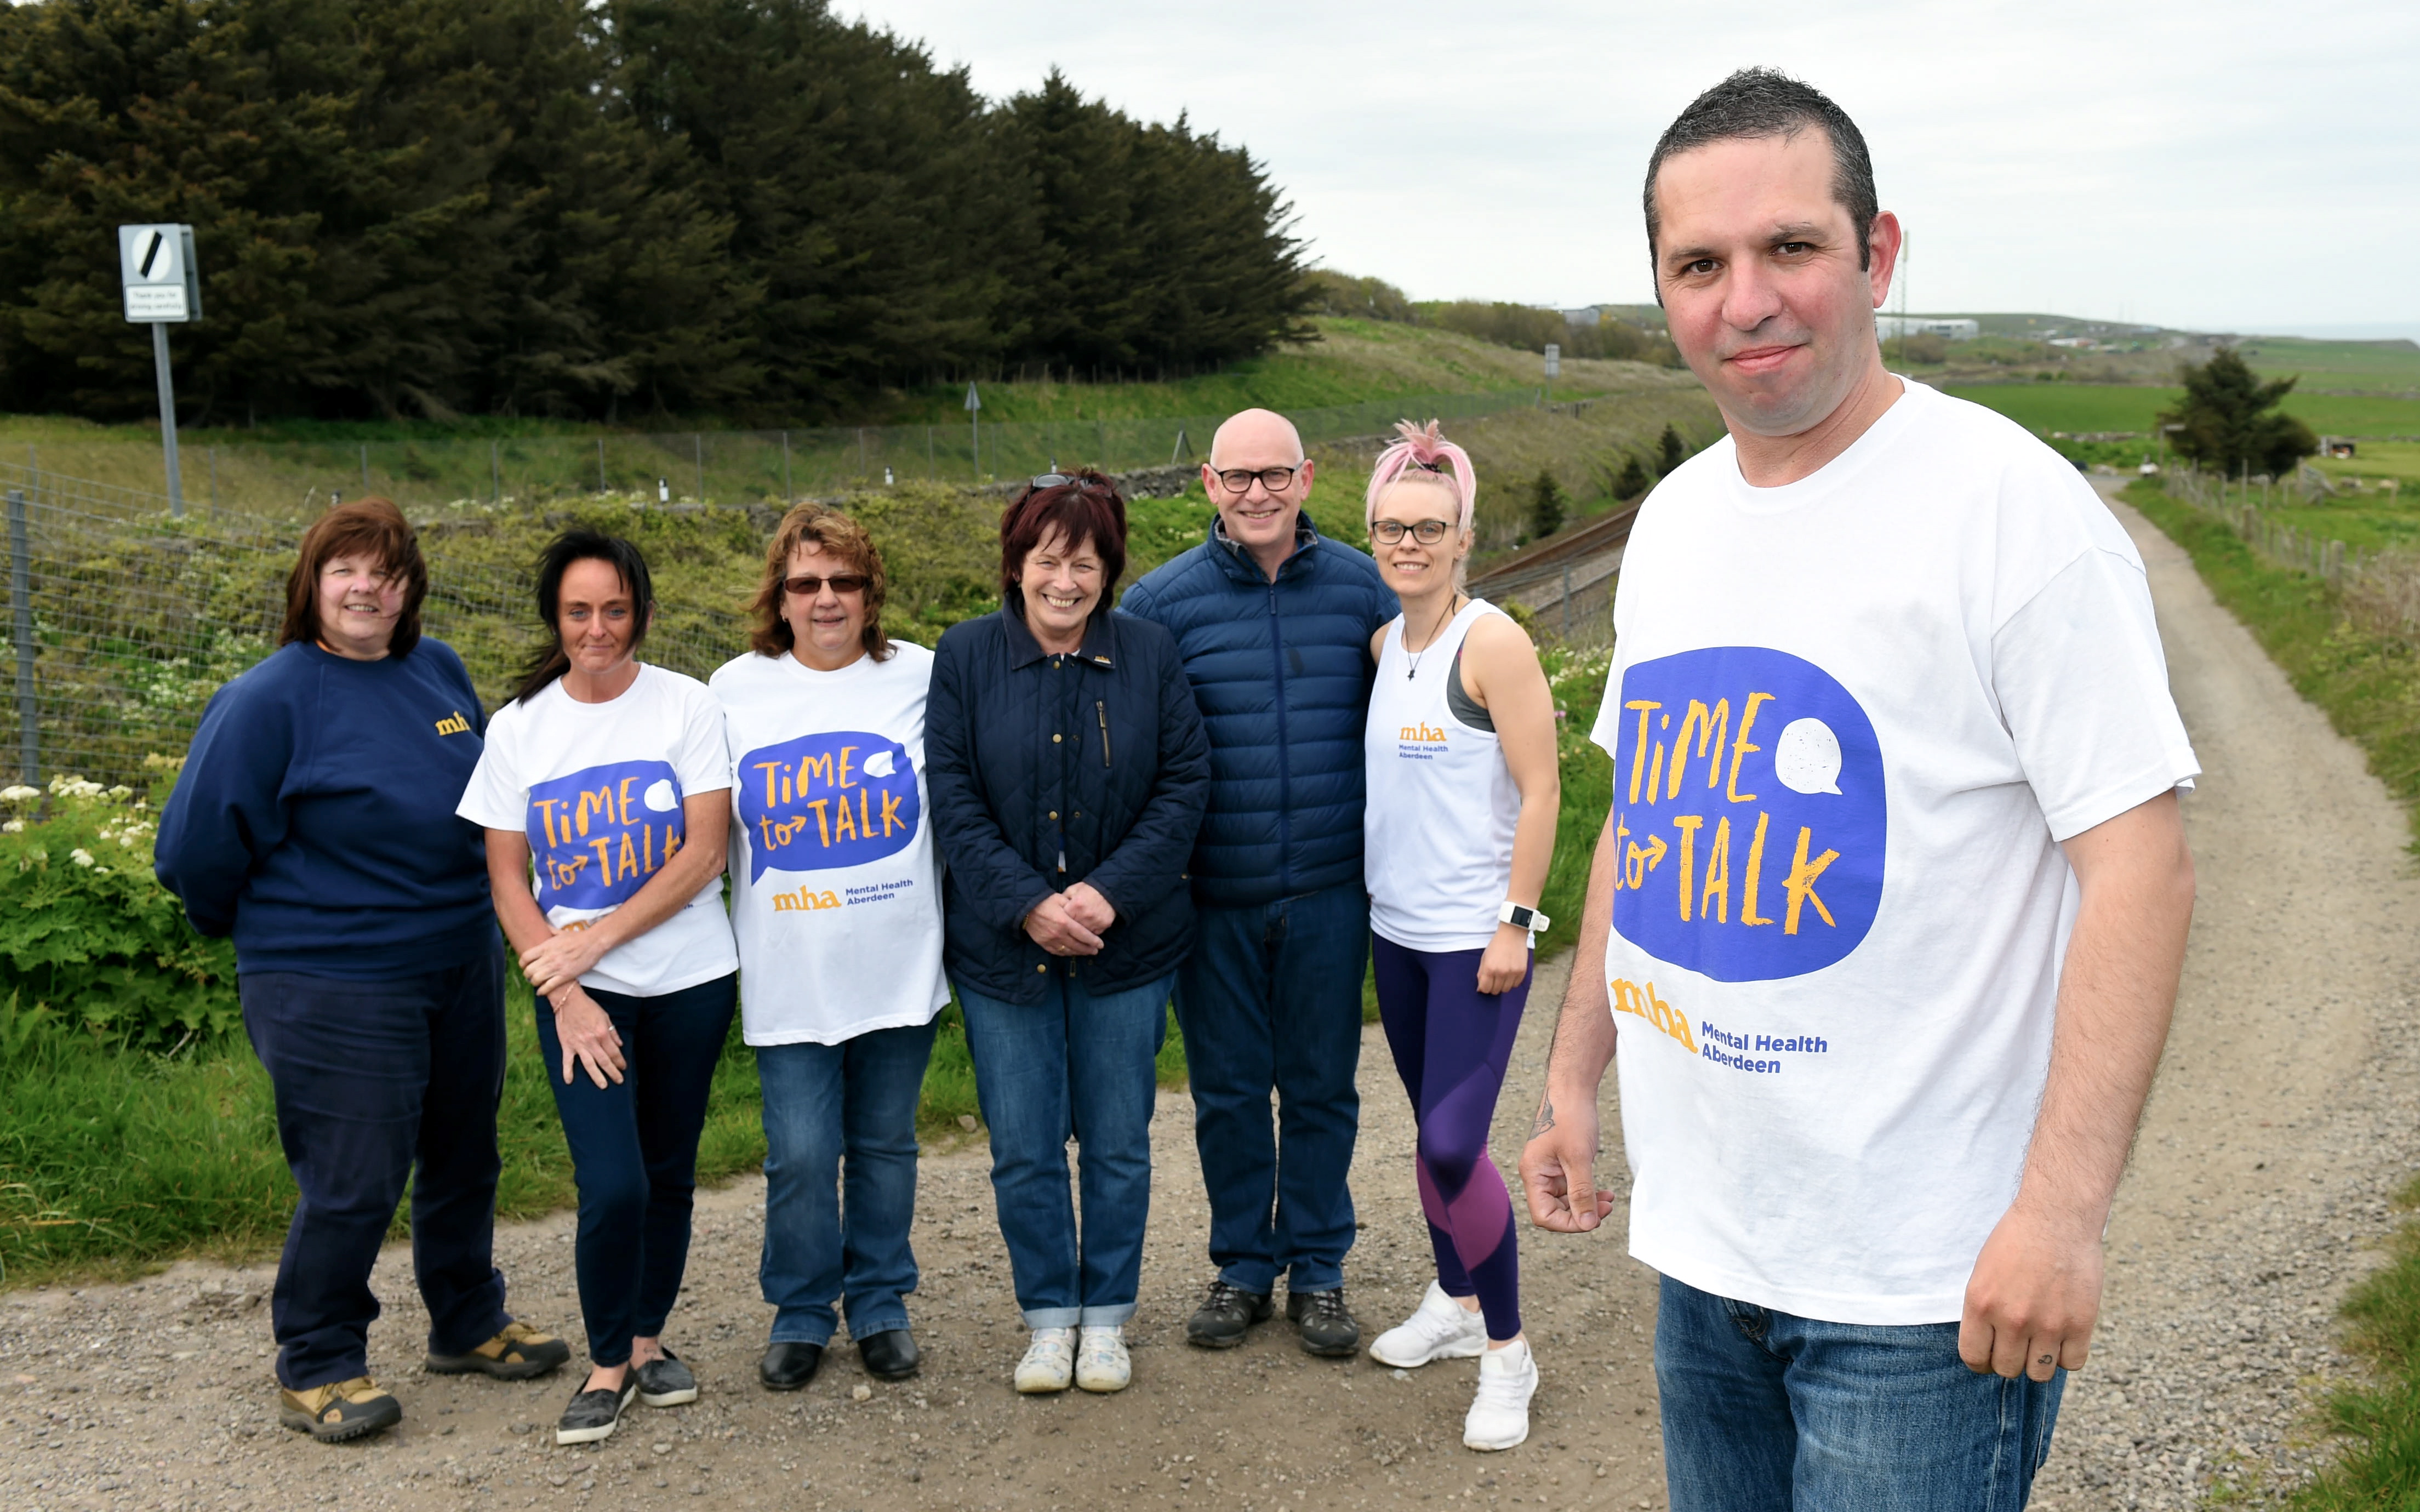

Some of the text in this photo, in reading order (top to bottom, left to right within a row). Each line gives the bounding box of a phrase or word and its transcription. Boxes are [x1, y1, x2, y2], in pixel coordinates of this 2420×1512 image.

[1399, 721, 1447, 741] mha
[759, 788, 906, 851] to TALK
[546, 854, 577, 890] to
[846, 879, 914, 896] Mental Health
[1673, 811, 1841, 935] TALK
[772, 885, 842, 911] mha
[847, 892, 895, 905] Aberdeen
[1611, 978, 1698, 1054] mha
[1702, 1020, 1828, 1053] Mental Health
[1702, 1043, 1780, 1074] Aberdeen
